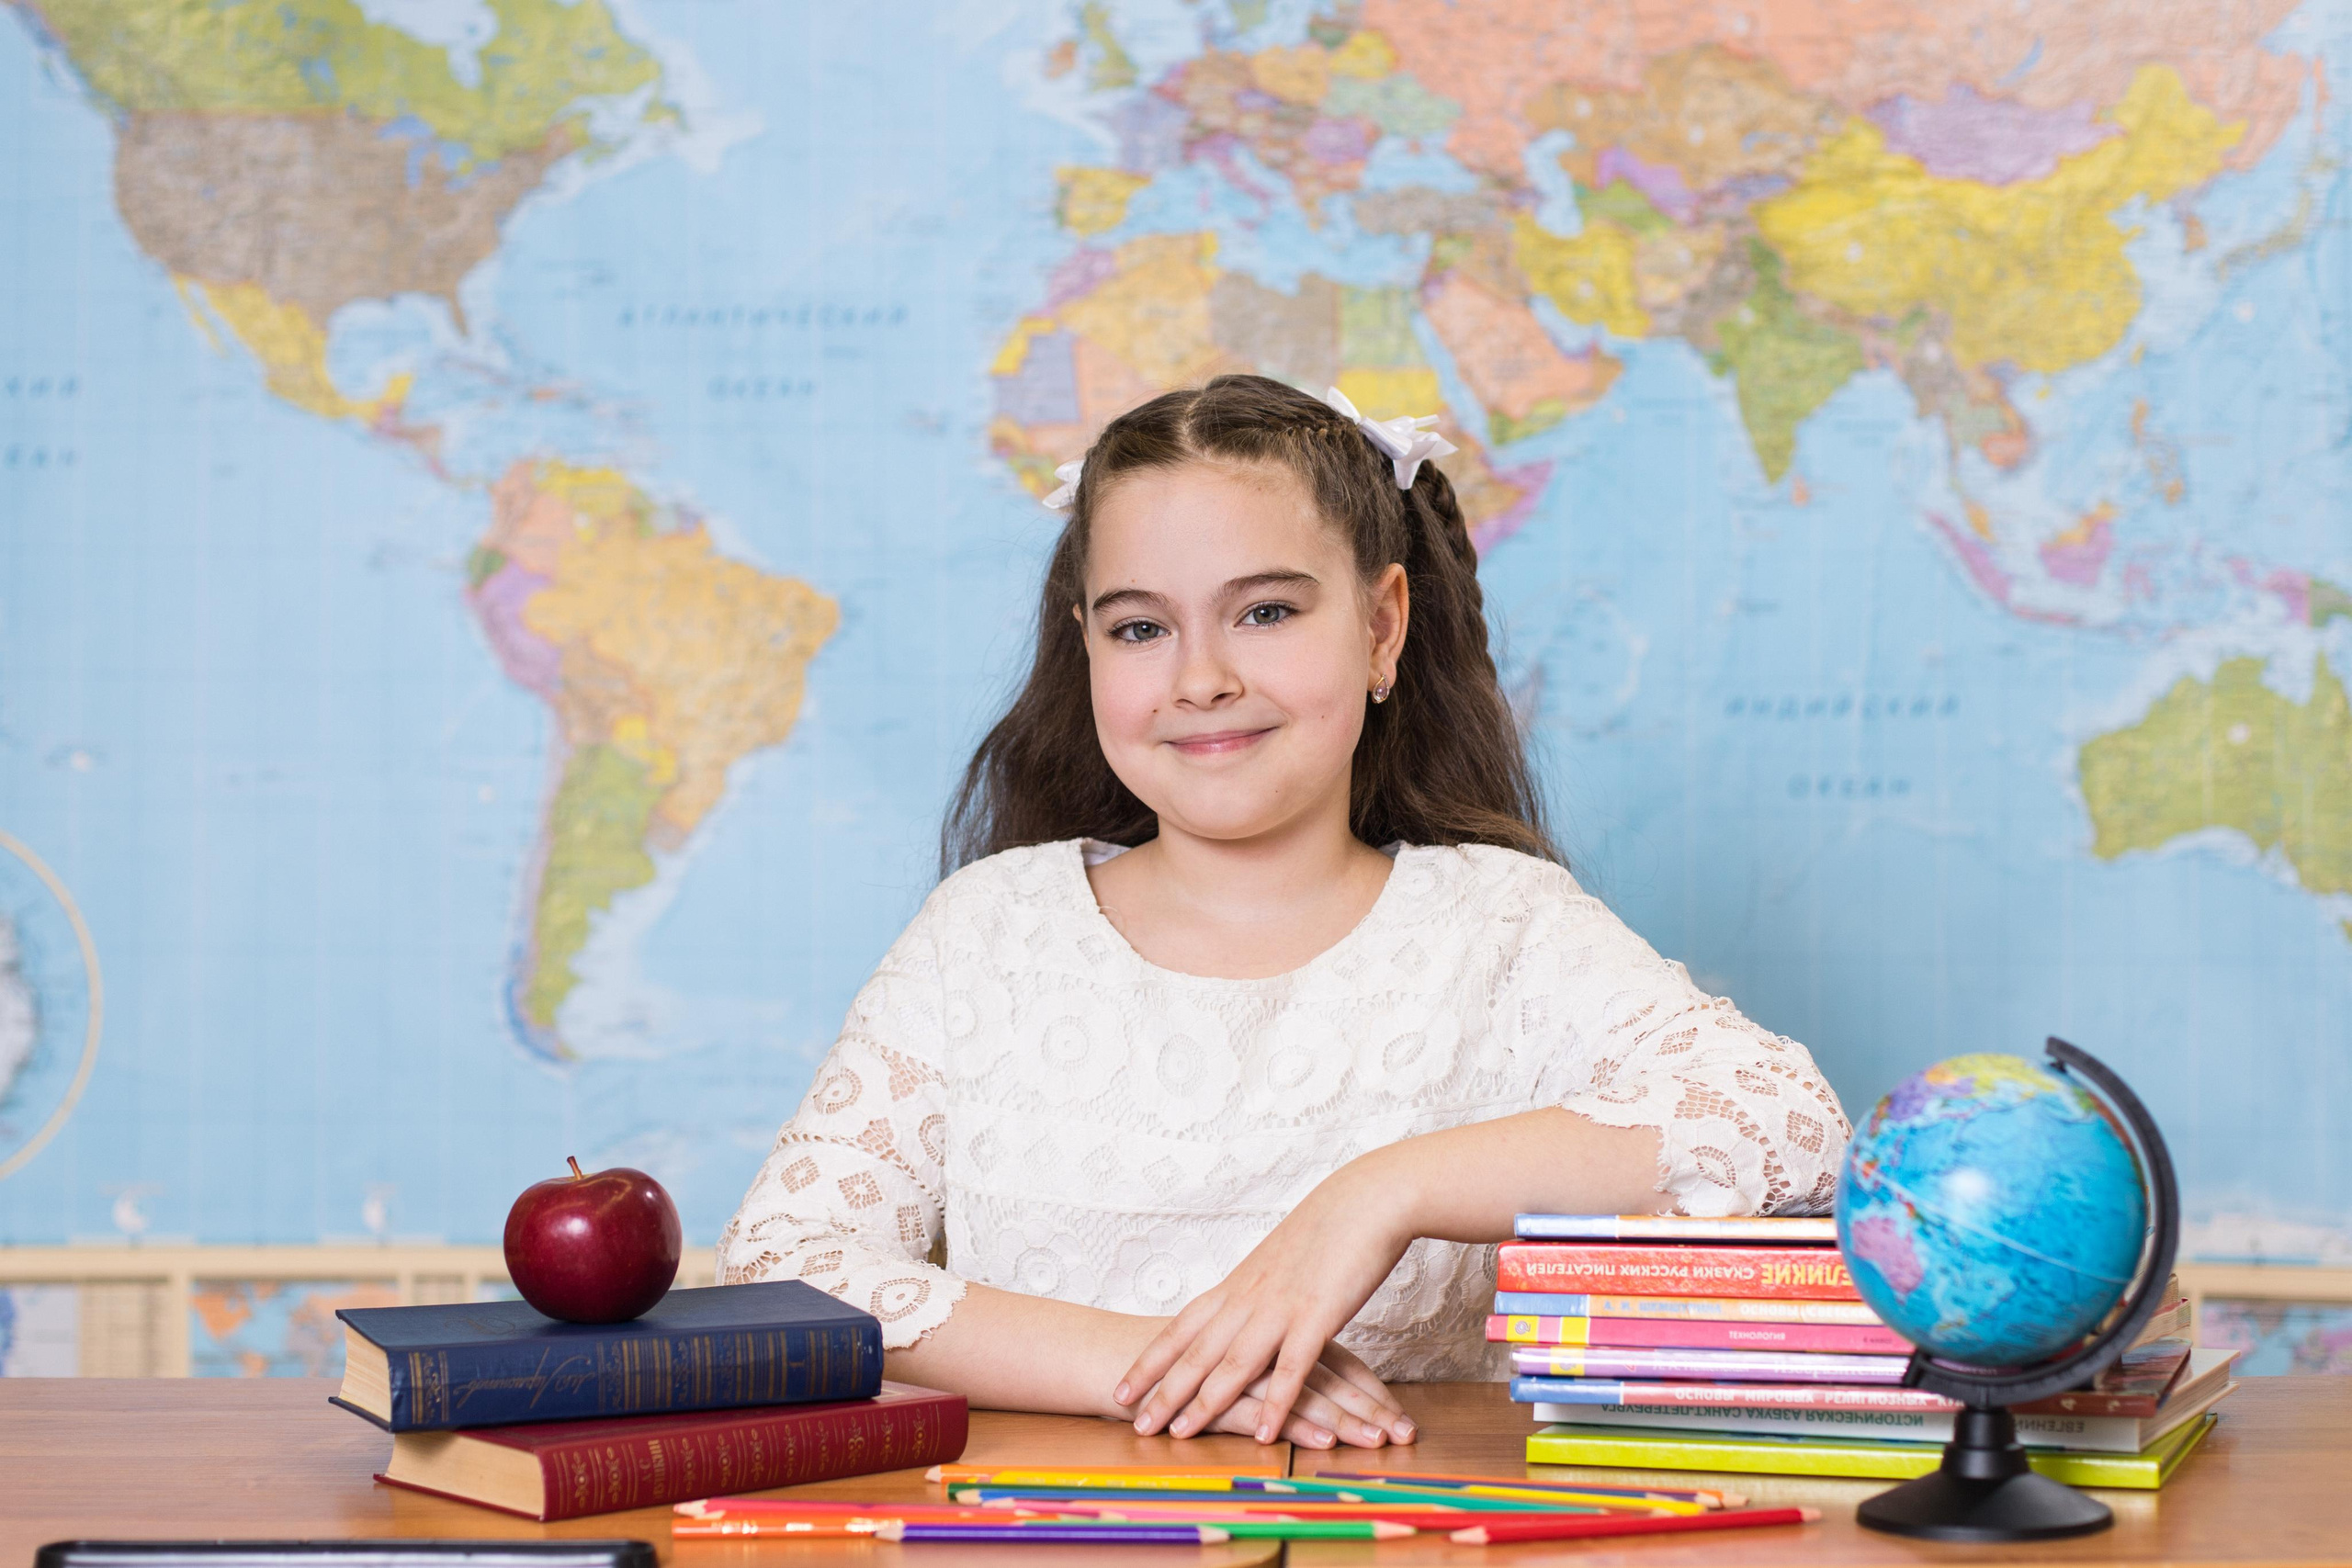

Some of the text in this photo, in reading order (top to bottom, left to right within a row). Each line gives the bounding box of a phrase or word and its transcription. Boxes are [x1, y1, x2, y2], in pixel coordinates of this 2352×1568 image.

[1526, 1262, 1855, 1286] ЕЛИКИЕ СКАЗКИ РУССКИХ ПИСАТЕЛЕЙ
[1729, 1331, 1785, 1341] ТЕХНОЛОГИЯ
[1674, 1388, 1736, 1401] ОСНОВЫ
[1747, 1406, 1802, 1420] АЗБУКА
